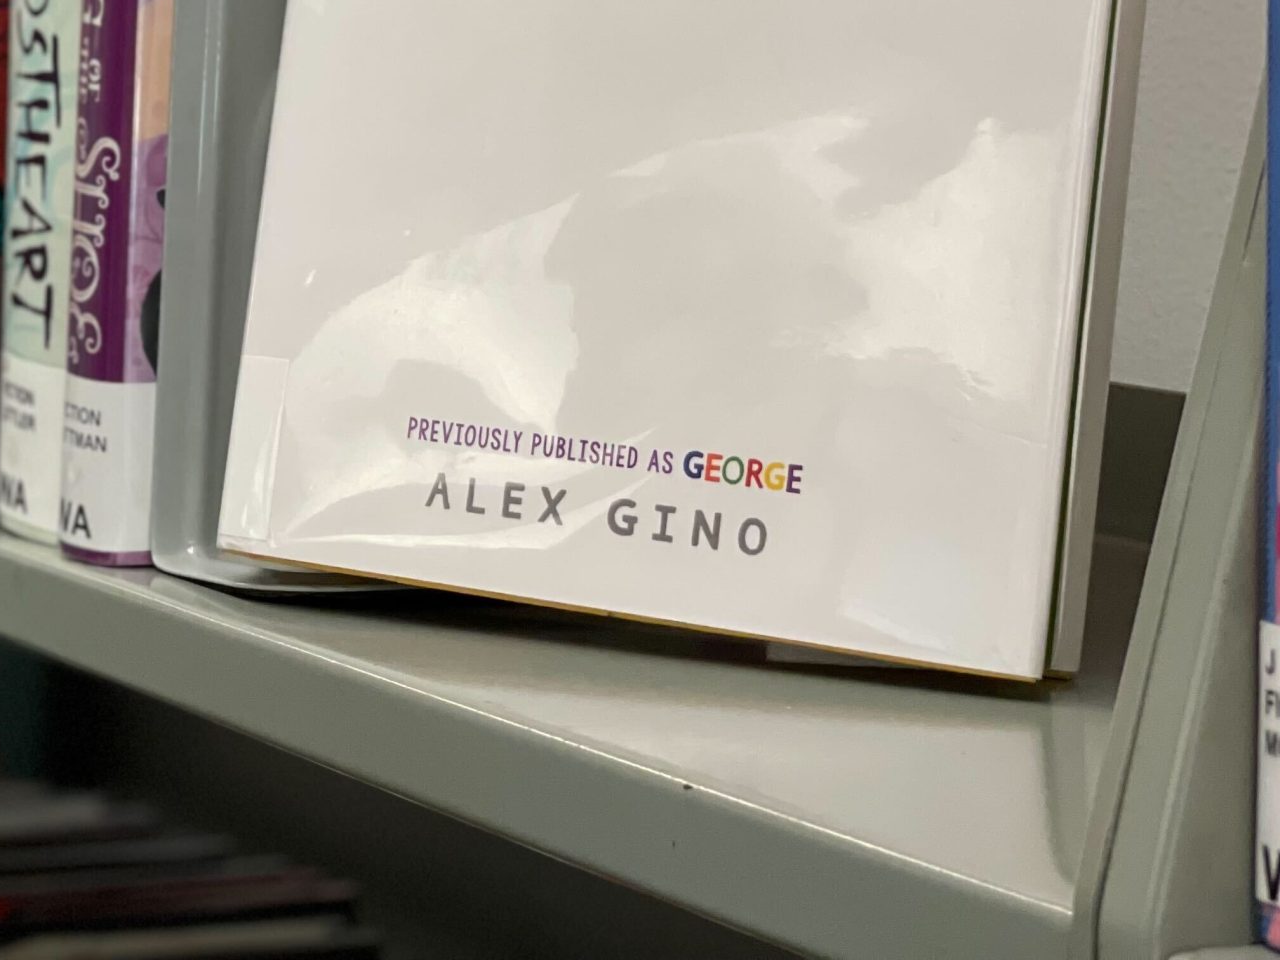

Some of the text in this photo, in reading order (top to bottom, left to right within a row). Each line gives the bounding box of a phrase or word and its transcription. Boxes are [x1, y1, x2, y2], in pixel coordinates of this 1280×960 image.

[407, 416, 804, 494] PREVIOUSLY PUBLISHED AS GEORGE
[425, 471, 768, 556] ALEX GINO
